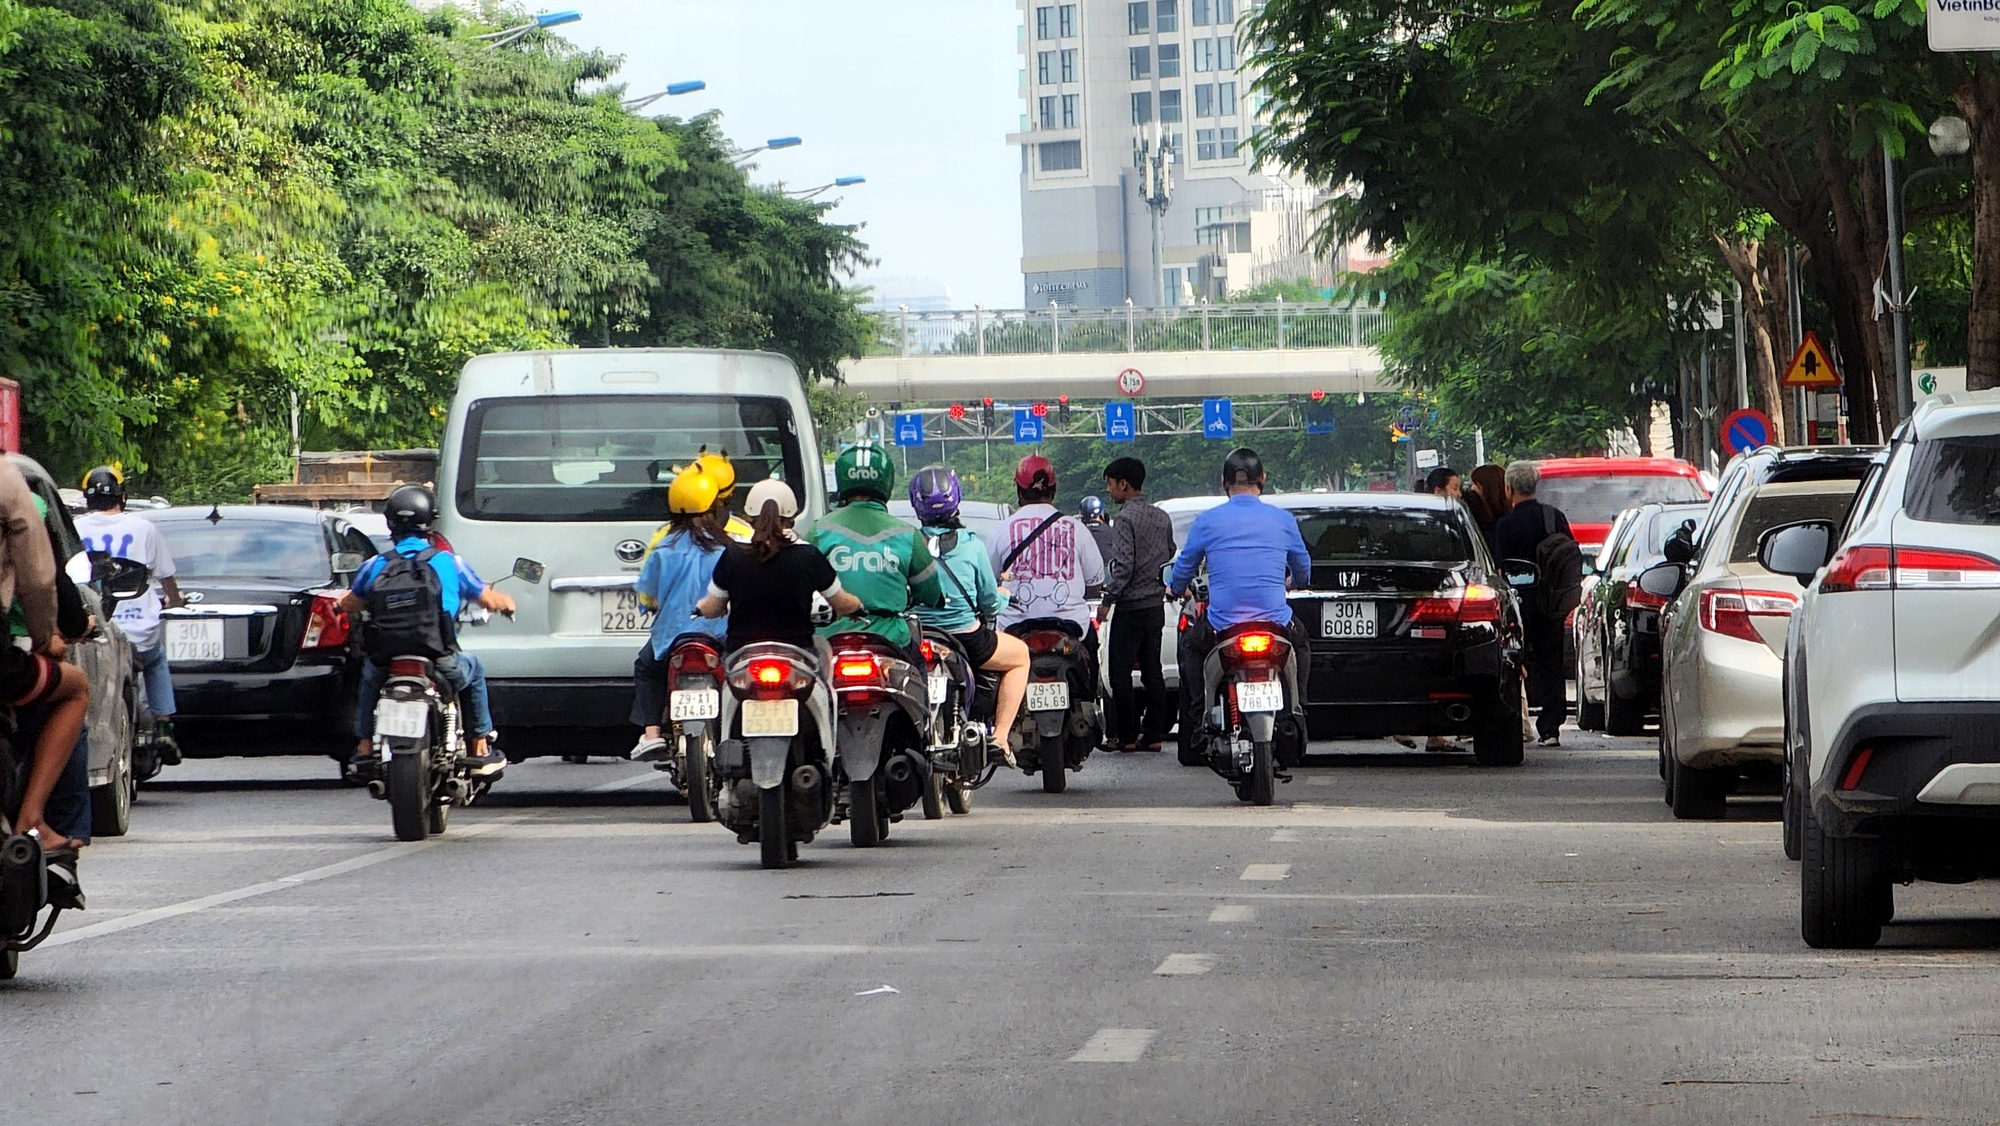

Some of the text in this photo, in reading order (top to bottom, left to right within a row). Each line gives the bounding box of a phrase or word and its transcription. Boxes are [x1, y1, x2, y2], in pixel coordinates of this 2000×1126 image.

[847, 466, 879, 480] Grab
[829, 545, 900, 573] Grab
[1335, 602, 1363, 618] 30A
[179, 623, 209, 640] 30A
[1325, 620, 1374, 636] 608.68
[1032, 684, 1062, 696] 29-S1
[1243, 683, 1274, 696] 29-Z1
[678, 693, 710, 705] 29-X1
[1030, 696, 1066, 709] 854.69
[675, 705, 713, 718] 214.61
[751, 702, 789, 717] 29-F1
[746, 718, 794, 734] 253.93
